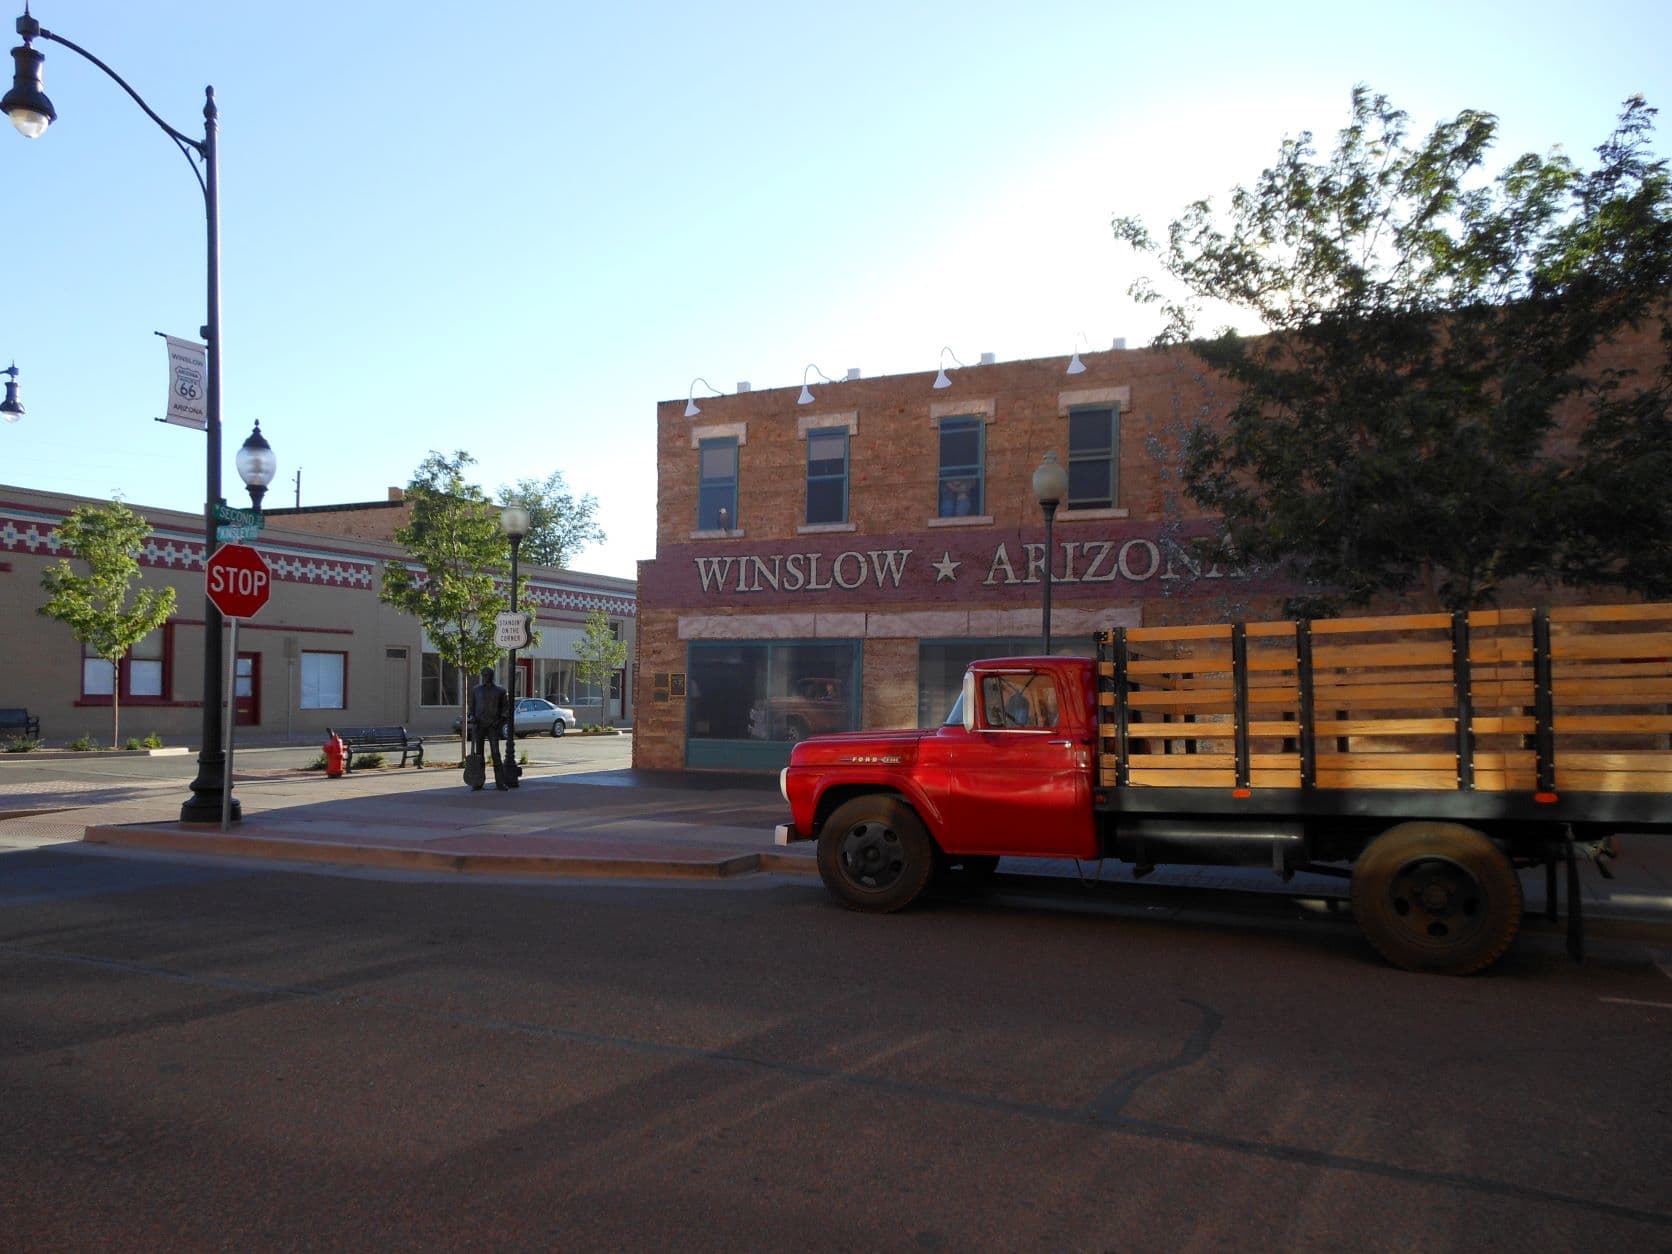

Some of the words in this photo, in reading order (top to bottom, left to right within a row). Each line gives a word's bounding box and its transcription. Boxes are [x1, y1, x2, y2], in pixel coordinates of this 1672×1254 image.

[171, 353, 203, 367] WINSLOW
[180, 382, 196, 398] 66
[173, 403, 203, 415] ARIZONA
[220, 507, 254, 525] SECOND
[695, 549, 912, 594] WINSLOW
[210, 565, 267, 597] STOP
